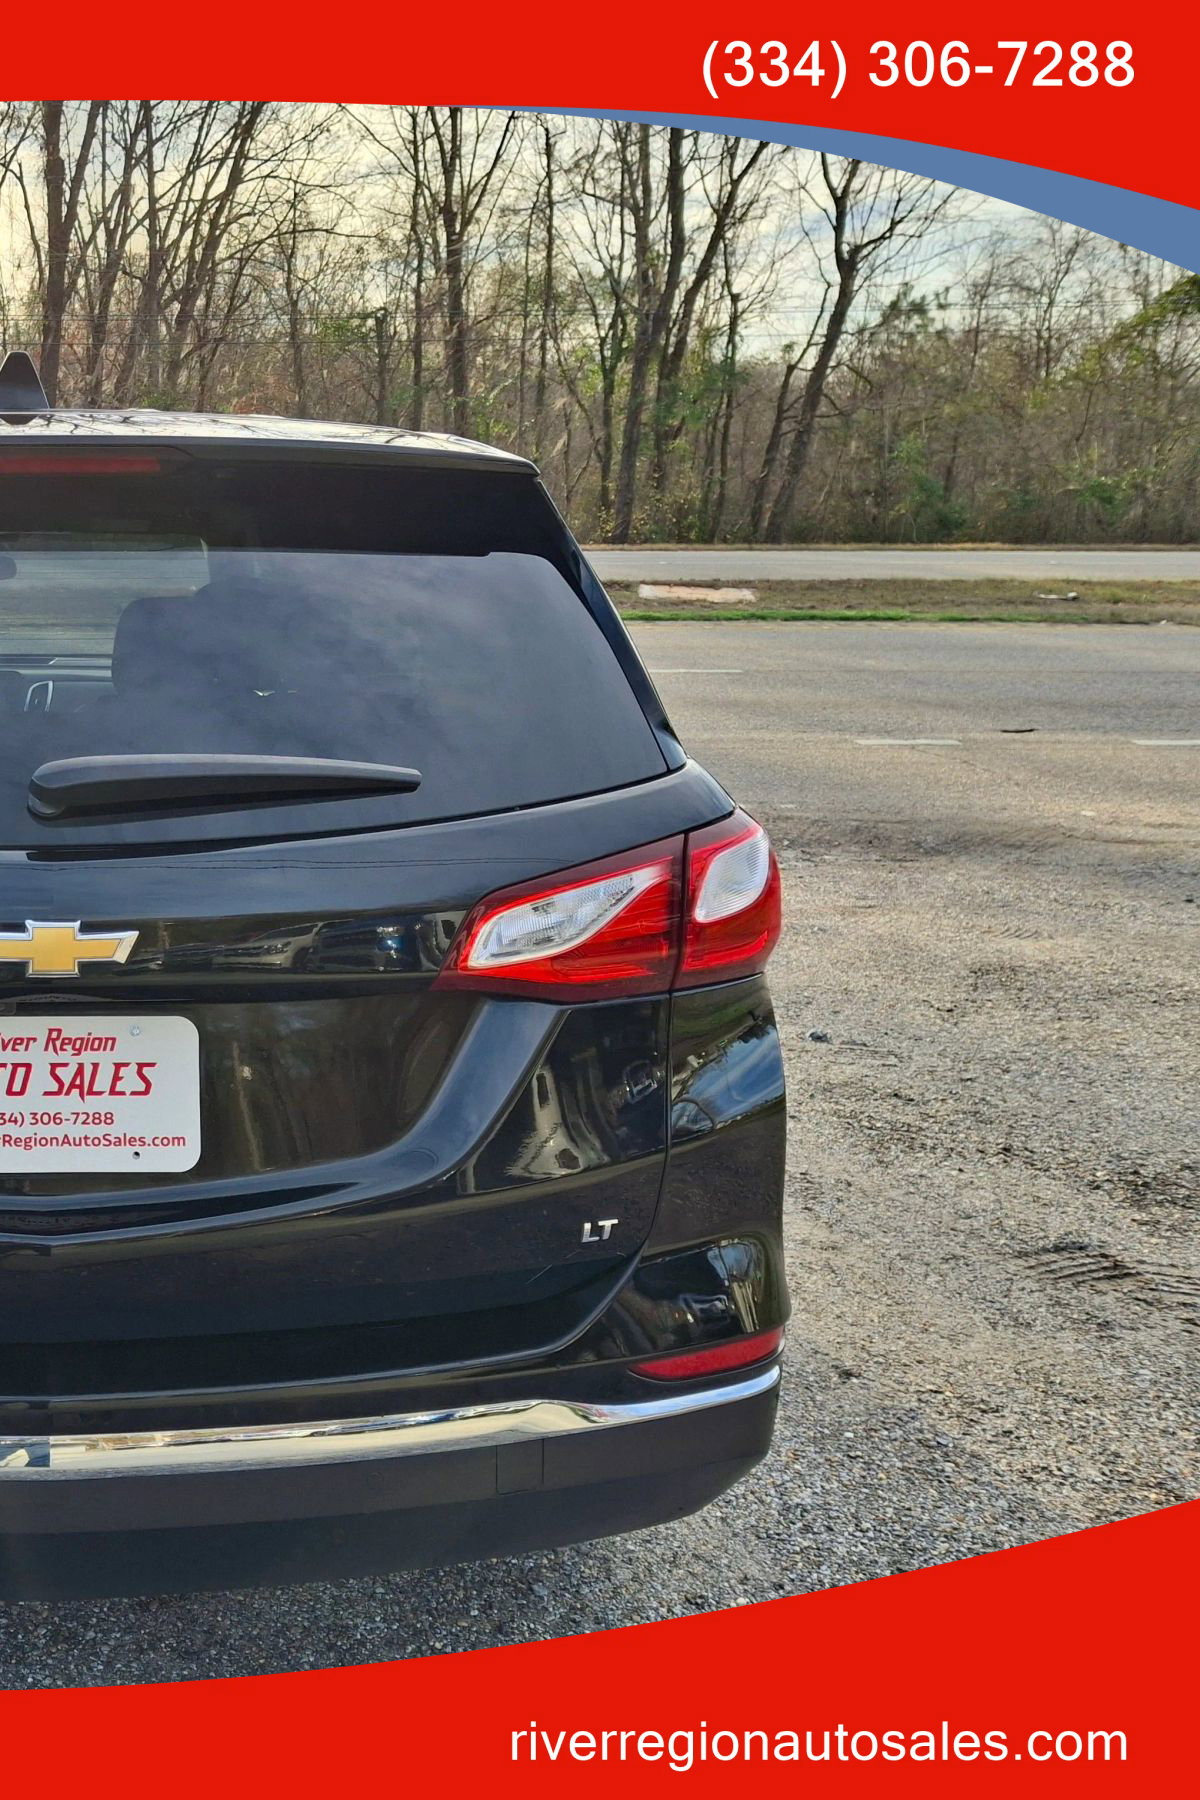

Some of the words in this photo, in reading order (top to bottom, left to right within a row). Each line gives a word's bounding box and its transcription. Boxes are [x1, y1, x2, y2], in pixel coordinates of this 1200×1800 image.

[43, 1027, 118, 1057] Region
[41, 1062, 158, 1104] SALES
[29, 1111, 115, 1126] 306-7288
[581, 1218, 619, 1243] LT
